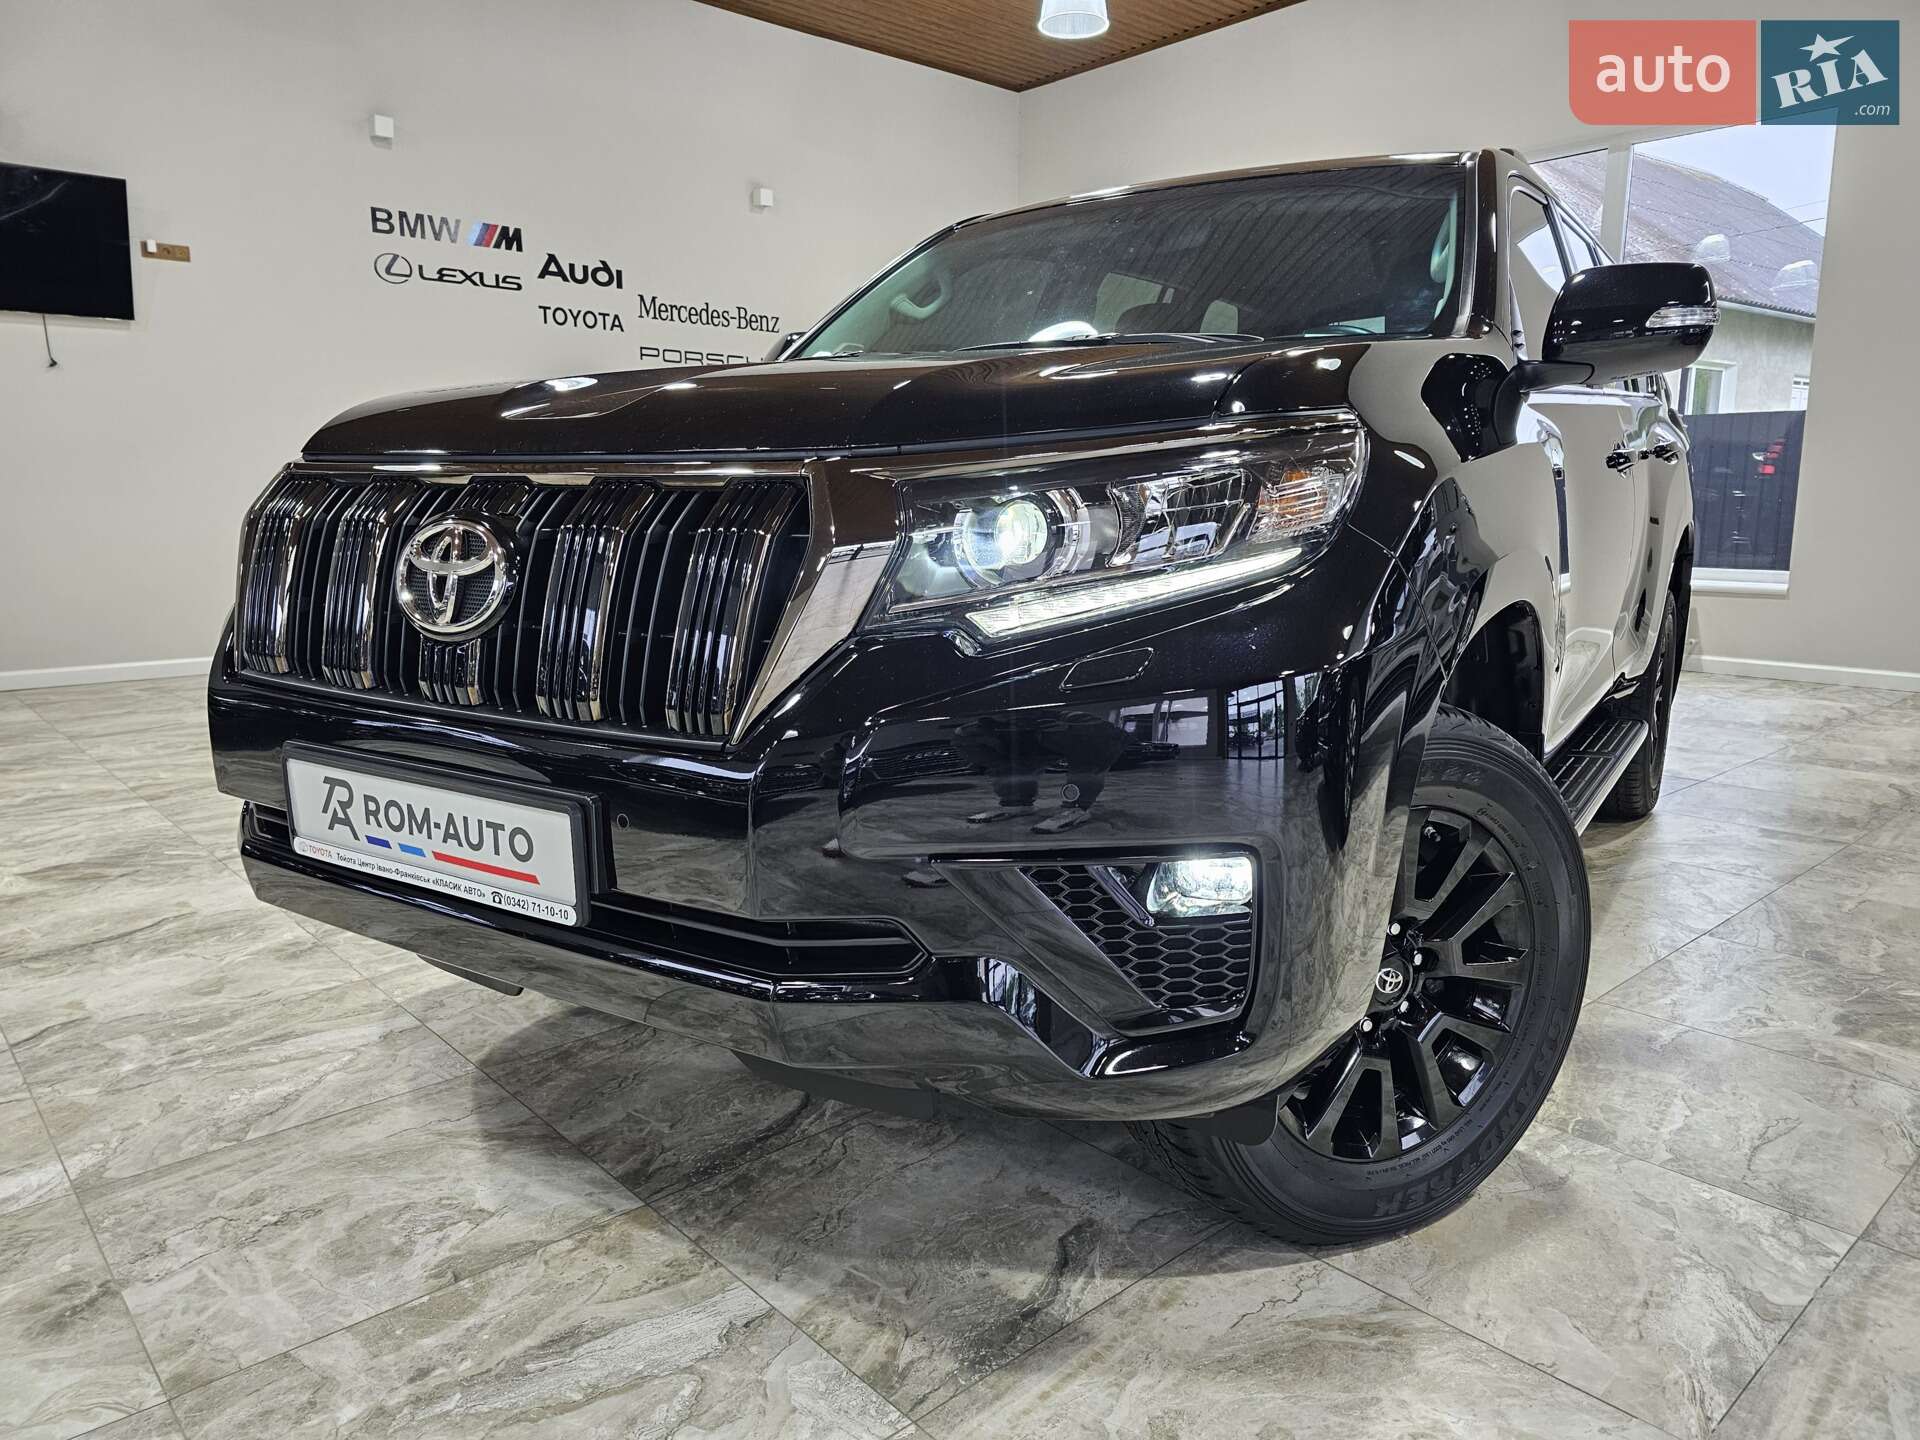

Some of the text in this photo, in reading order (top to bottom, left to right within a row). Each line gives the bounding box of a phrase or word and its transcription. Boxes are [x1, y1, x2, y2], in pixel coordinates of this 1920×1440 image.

[370, 206, 461, 244] BMW
[418, 264, 523, 291] LEXUS
[537, 253, 624, 290] Audi
[538, 305, 625, 333] TOYOTA
[638, 294, 781, 334] Mercedes-Benz
[640, 346, 764, 366] PORSC
[363, 794, 535, 863] ROM-AUTO
[309, 844, 333, 859] TOYOTA
[503, 893, 530, 911] (0342)
[531, 902, 570, 921] 71-10-10
